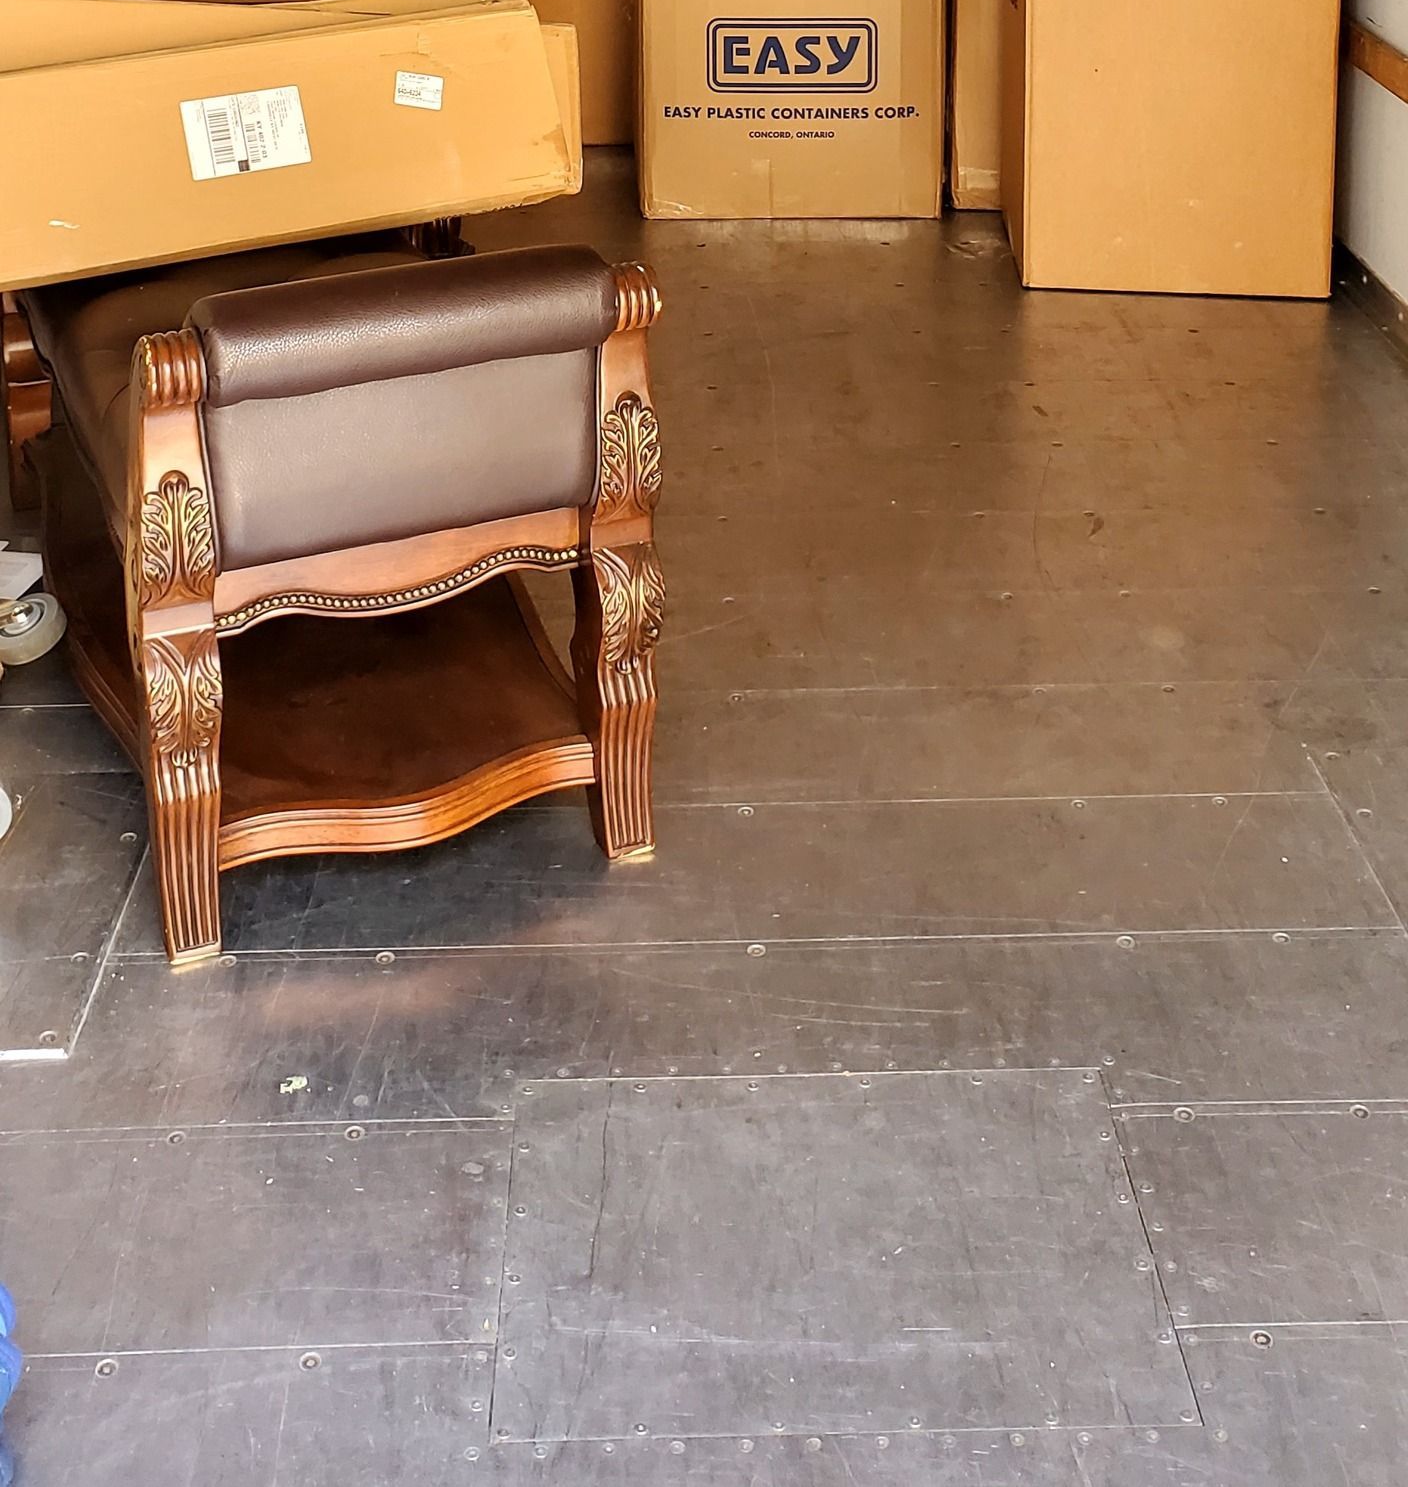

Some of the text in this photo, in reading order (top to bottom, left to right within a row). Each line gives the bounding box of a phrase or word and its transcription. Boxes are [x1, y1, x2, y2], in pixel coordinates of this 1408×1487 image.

[723, 35, 861, 75] EASY
[664, 105, 920, 119] EASY PLASTIC CONTAINERS CORP.
[749, 130, 835, 139] CONCORD, ONTARIO
